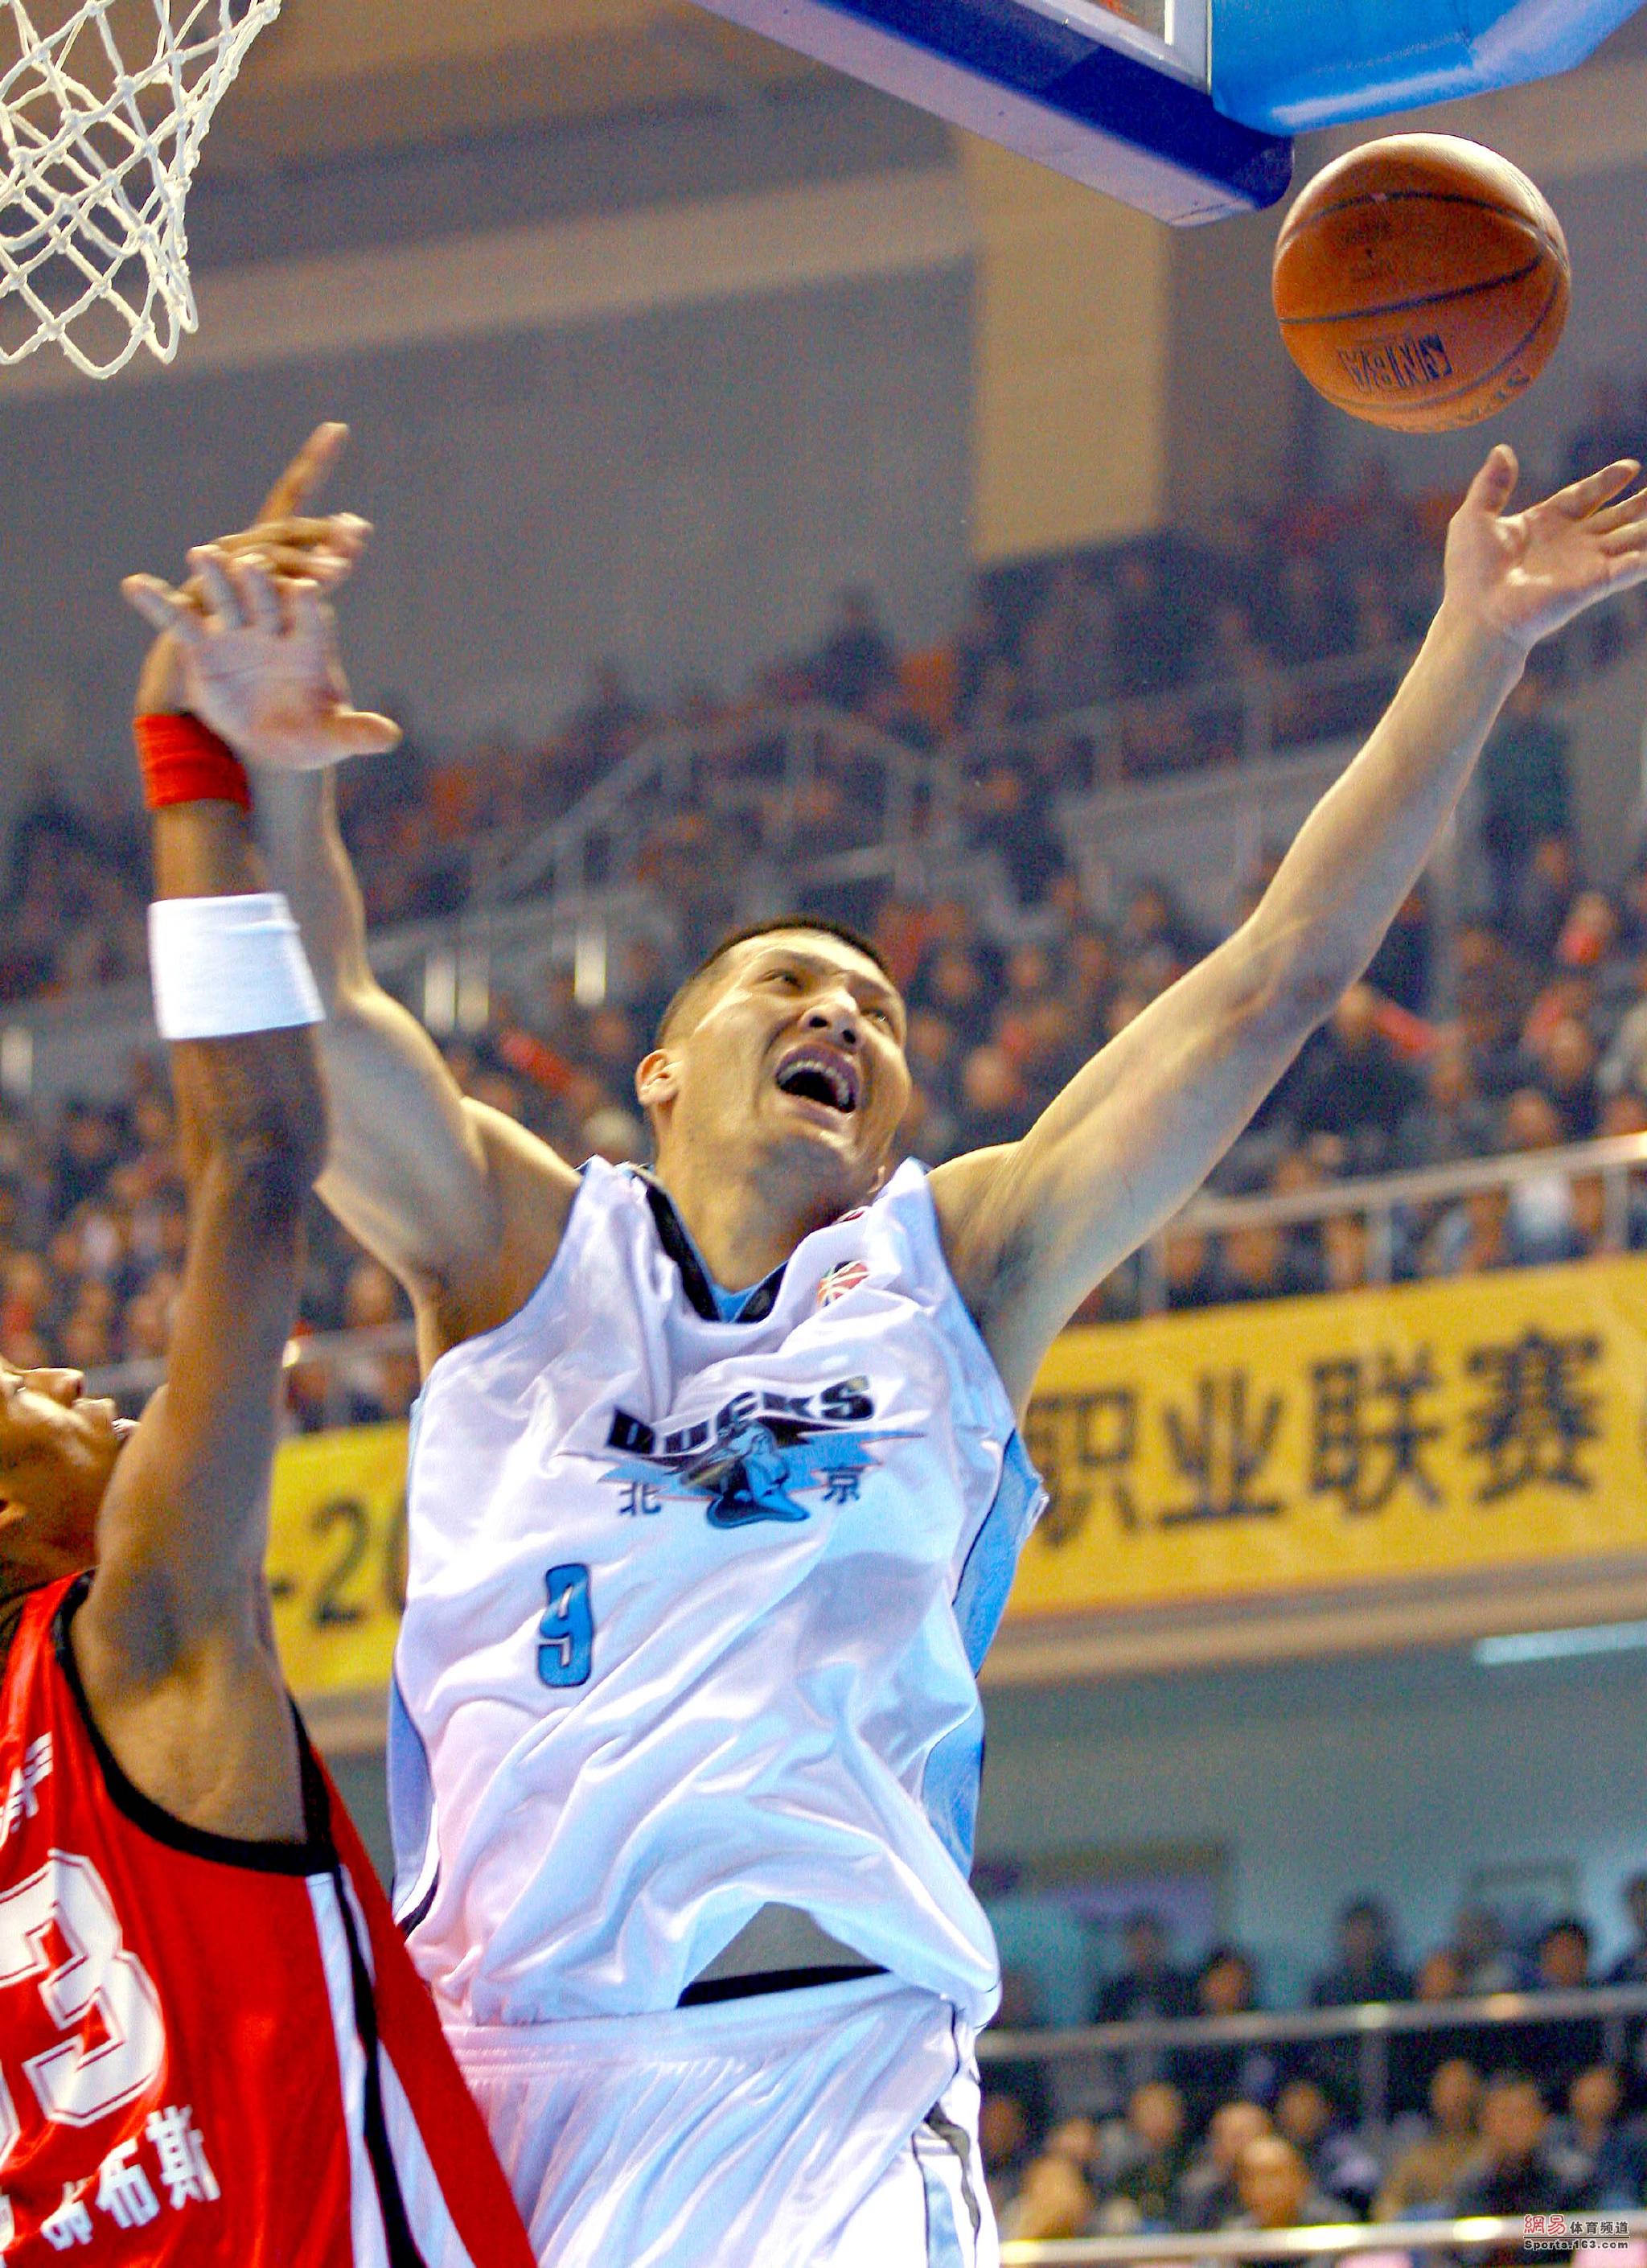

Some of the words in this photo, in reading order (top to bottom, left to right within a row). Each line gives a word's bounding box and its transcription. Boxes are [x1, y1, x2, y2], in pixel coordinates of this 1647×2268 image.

[618, 1480, 663, 1518] 北
[819, 1463, 868, 1506] 京
[1024, 1325, 1605, 1549] 职业联赛
[537, 1563, 593, 1688] 9
[0, 1848, 166, 2163] 3
